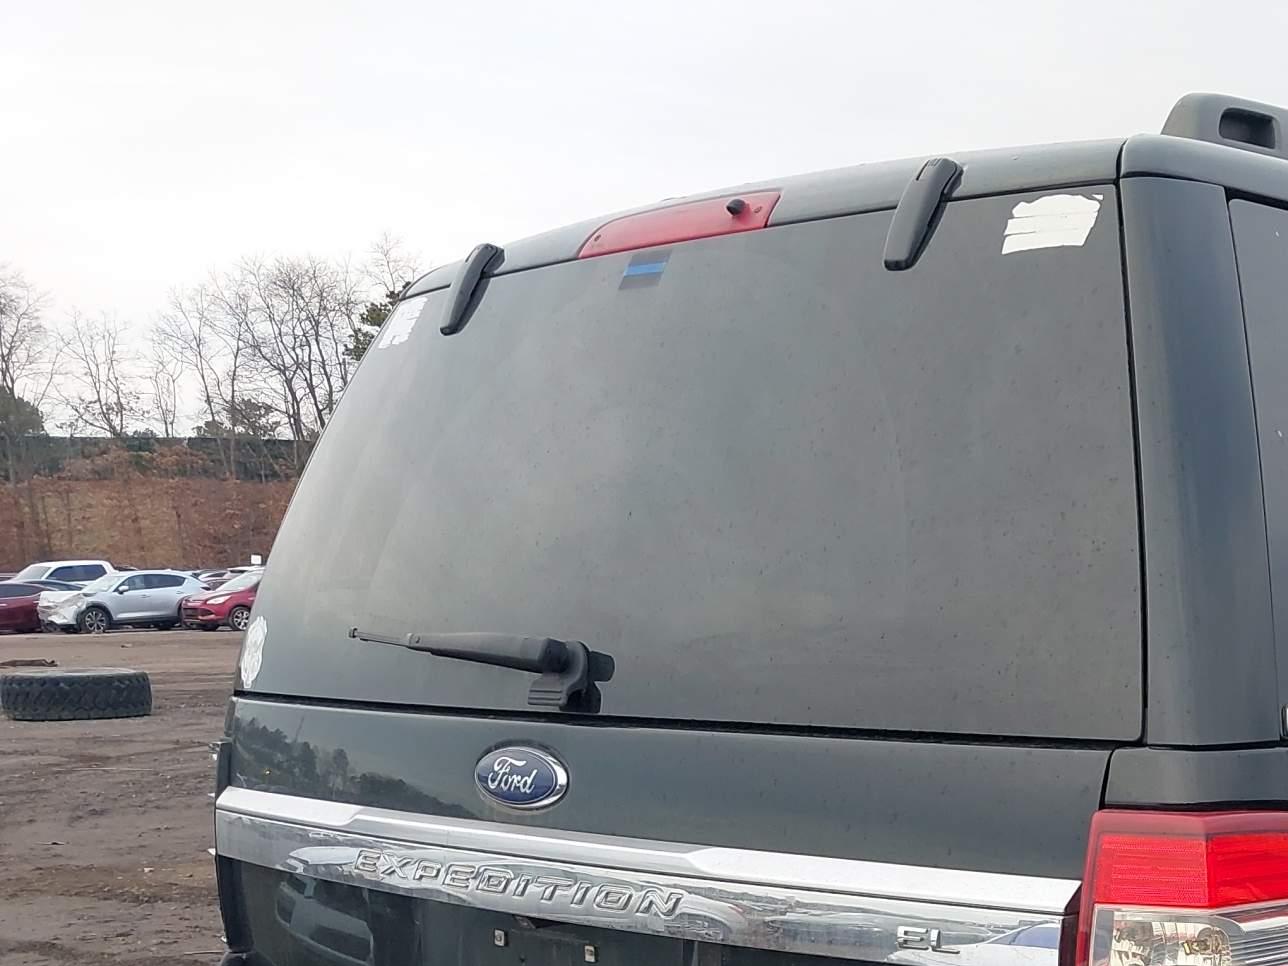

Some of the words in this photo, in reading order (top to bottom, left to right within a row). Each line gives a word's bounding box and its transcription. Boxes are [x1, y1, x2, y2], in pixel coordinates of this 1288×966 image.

[487, 756, 538, 794] Ford
[354, 848, 684, 917] EXPEDITION
[897, 925, 961, 955] EL
